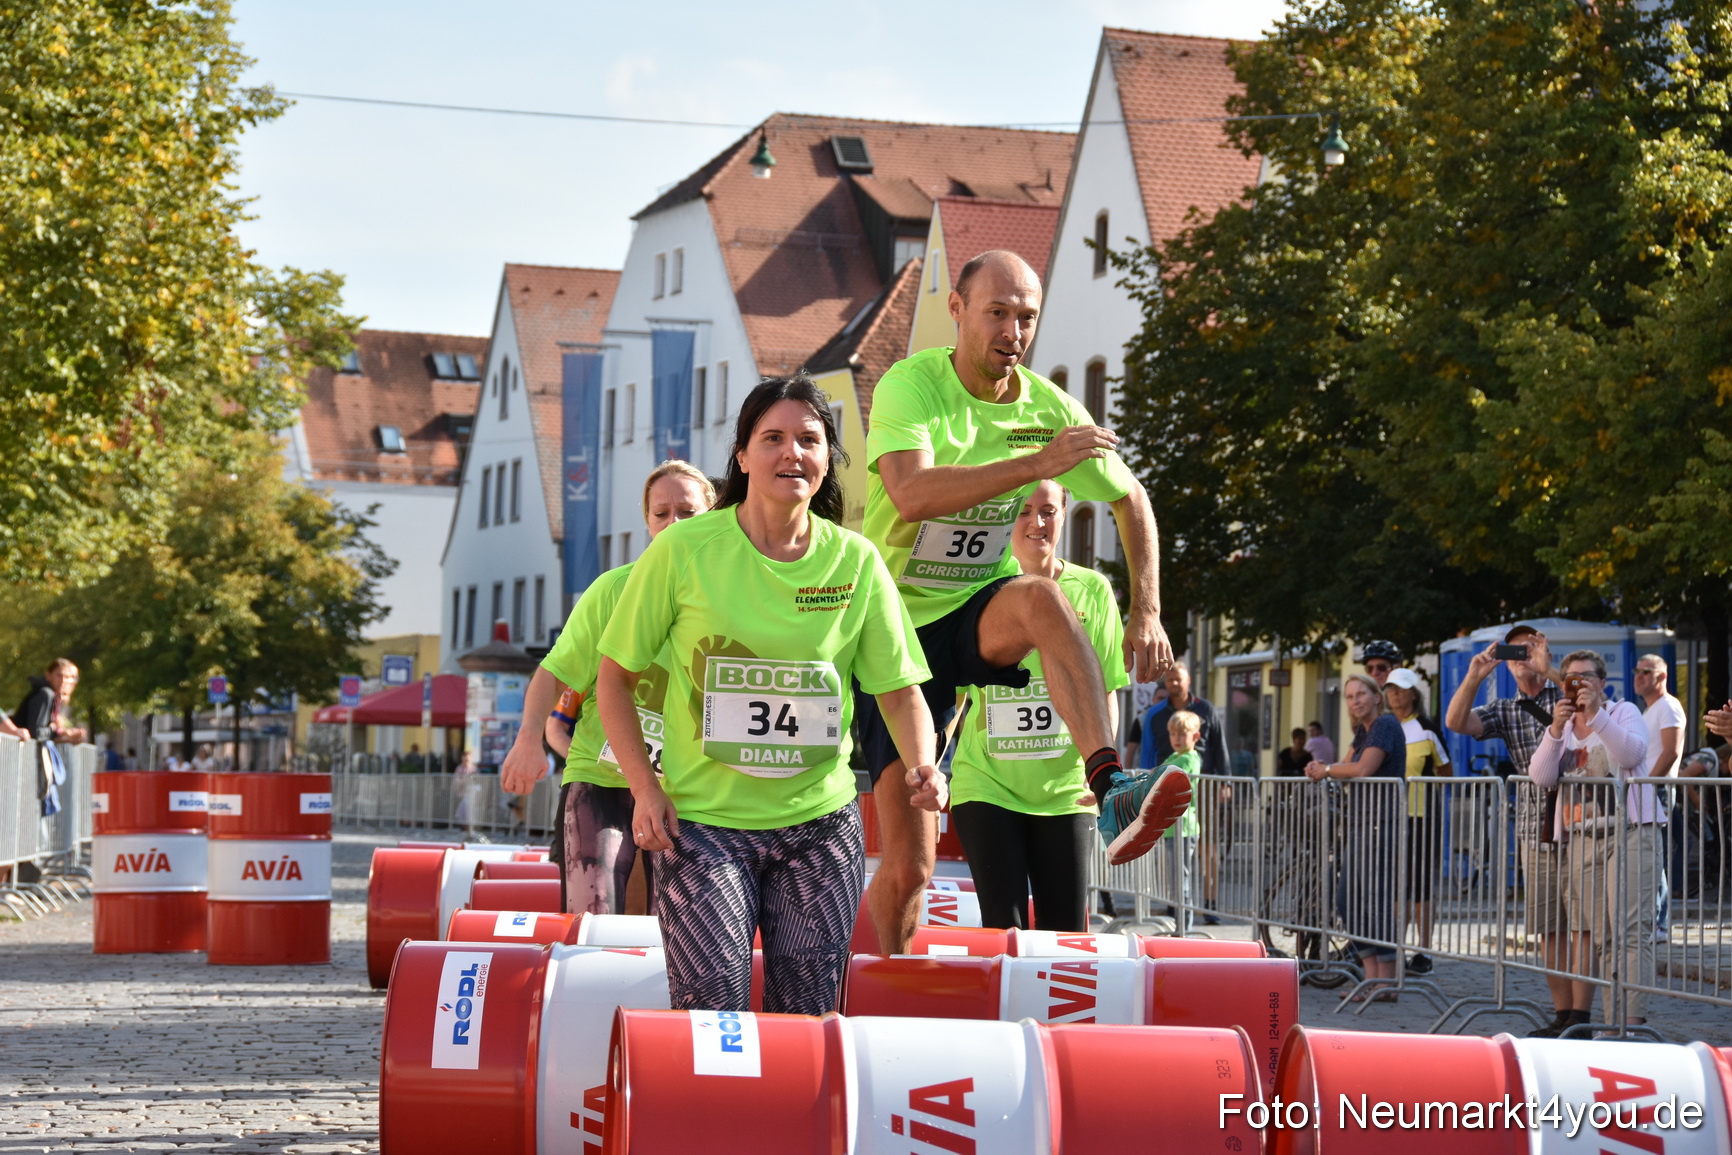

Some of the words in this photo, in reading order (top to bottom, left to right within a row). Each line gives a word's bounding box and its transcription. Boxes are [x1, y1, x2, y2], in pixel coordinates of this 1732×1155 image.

[567, 446, 588, 501] K&L
[945, 530, 989, 558] 36
[915, 563, 994, 579] CHRISTOPH
[798, 583, 853, 595] NEUMARKTER
[807, 604, 840, 612] September
[716, 663, 831, 693] BOCK
[993, 681, 1049, 700] BOC
[747, 701, 799, 737] 34
[1017, 706, 1052, 731] 39
[997, 736, 1073, 750] KATHARINA
[740, 748, 803, 764] DIANA
[1216, 1059, 1231, 1079] 323
